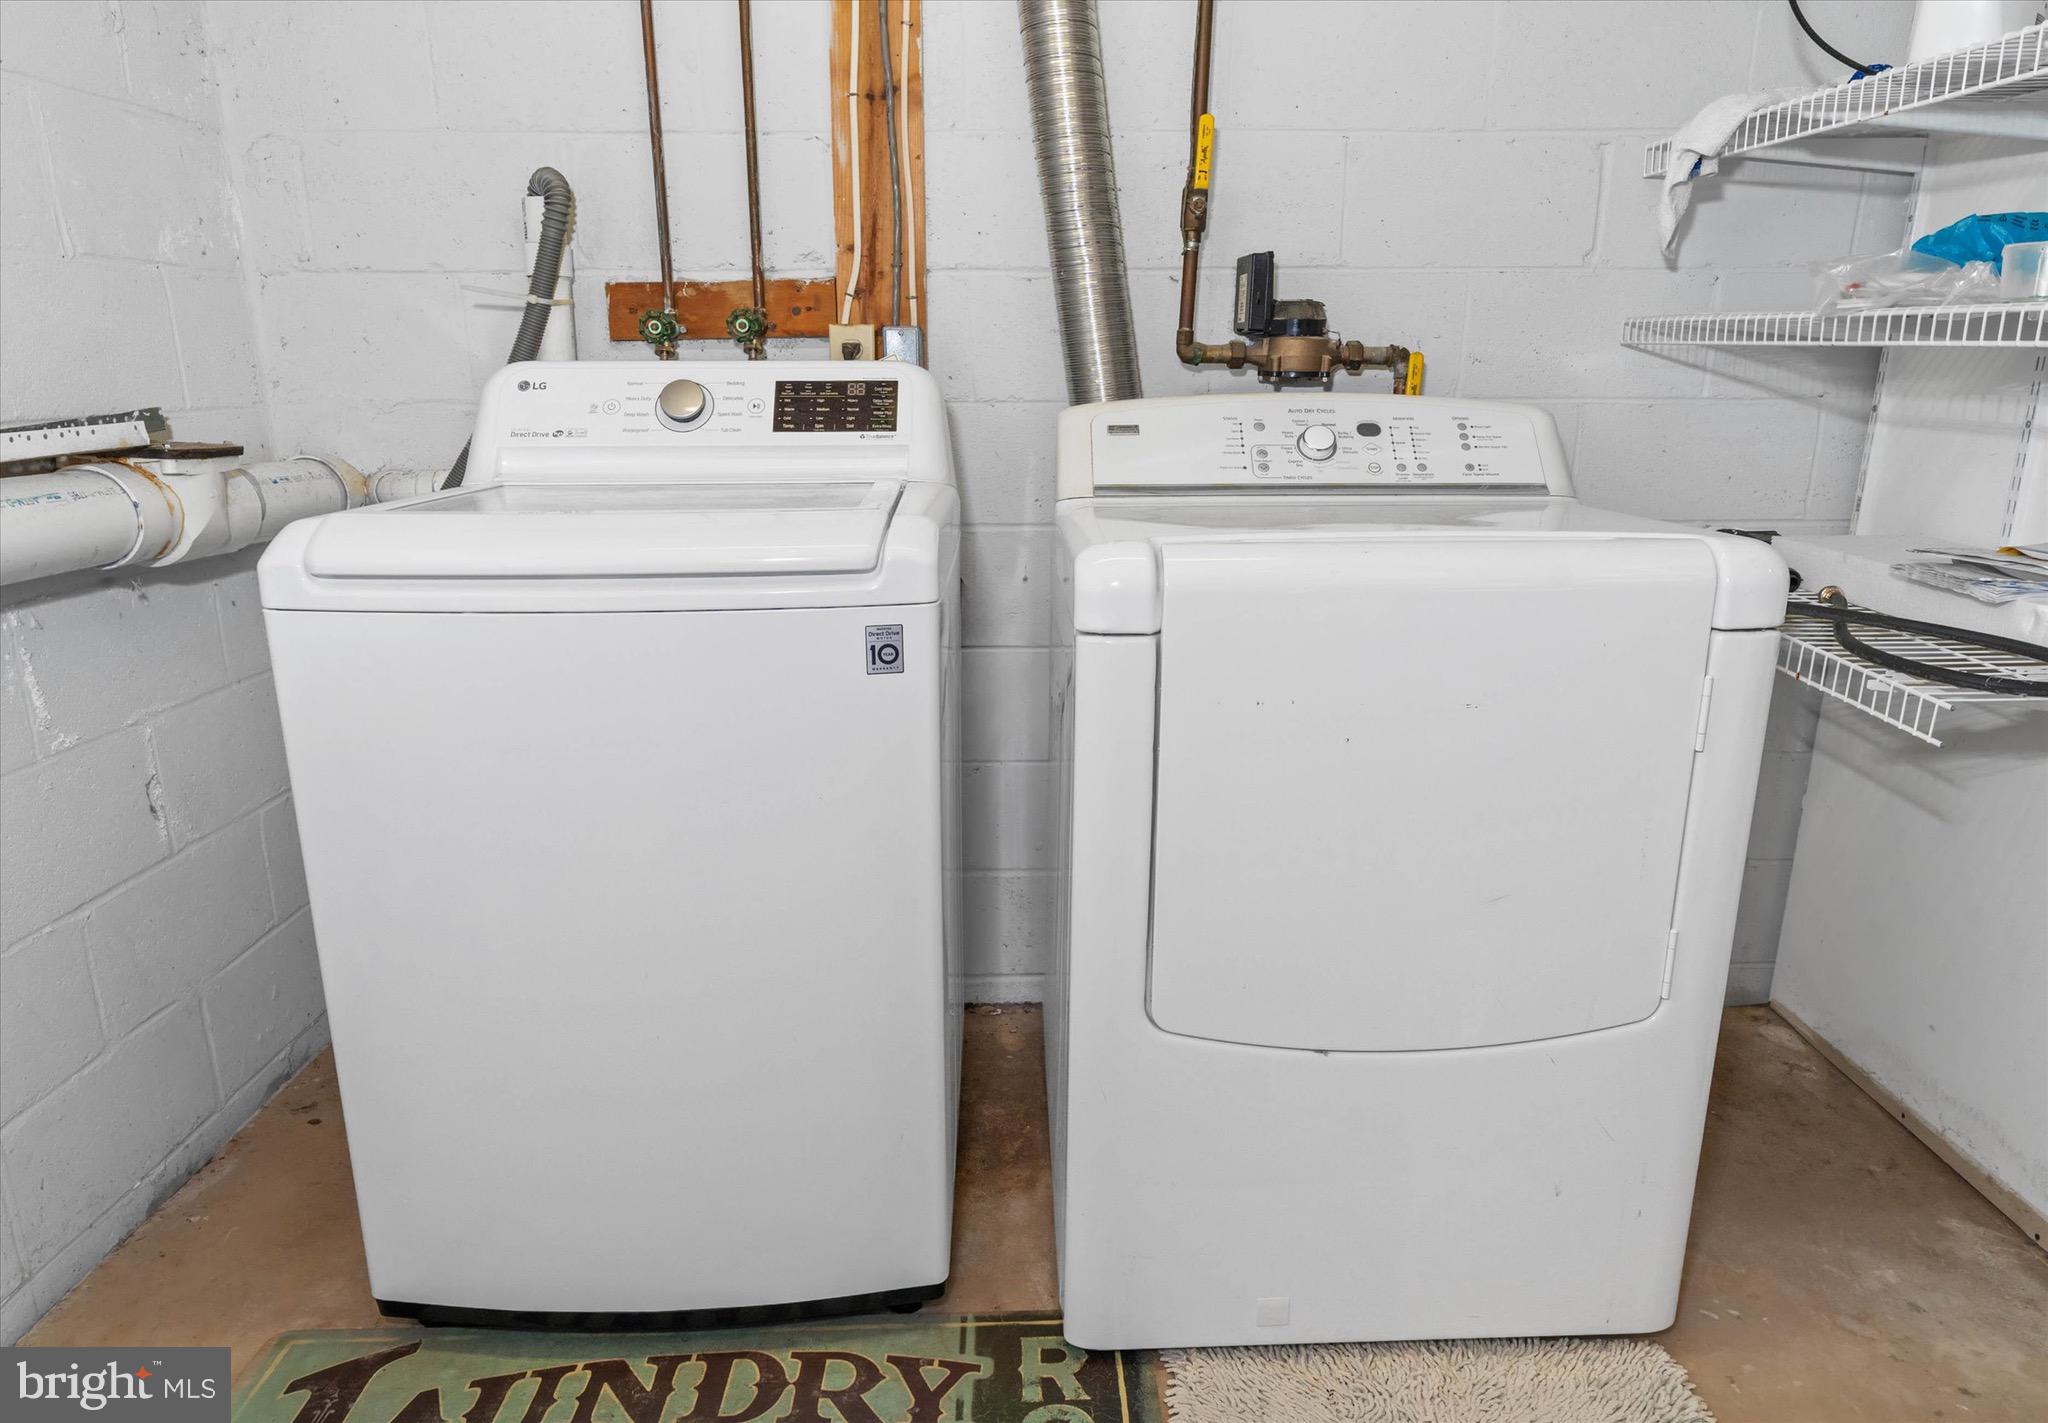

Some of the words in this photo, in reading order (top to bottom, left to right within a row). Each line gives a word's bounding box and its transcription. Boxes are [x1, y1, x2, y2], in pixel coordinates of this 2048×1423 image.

[532, 381, 547, 390] LG
[847, 383, 866, 396] 88
[870, 643, 899, 665] 10
